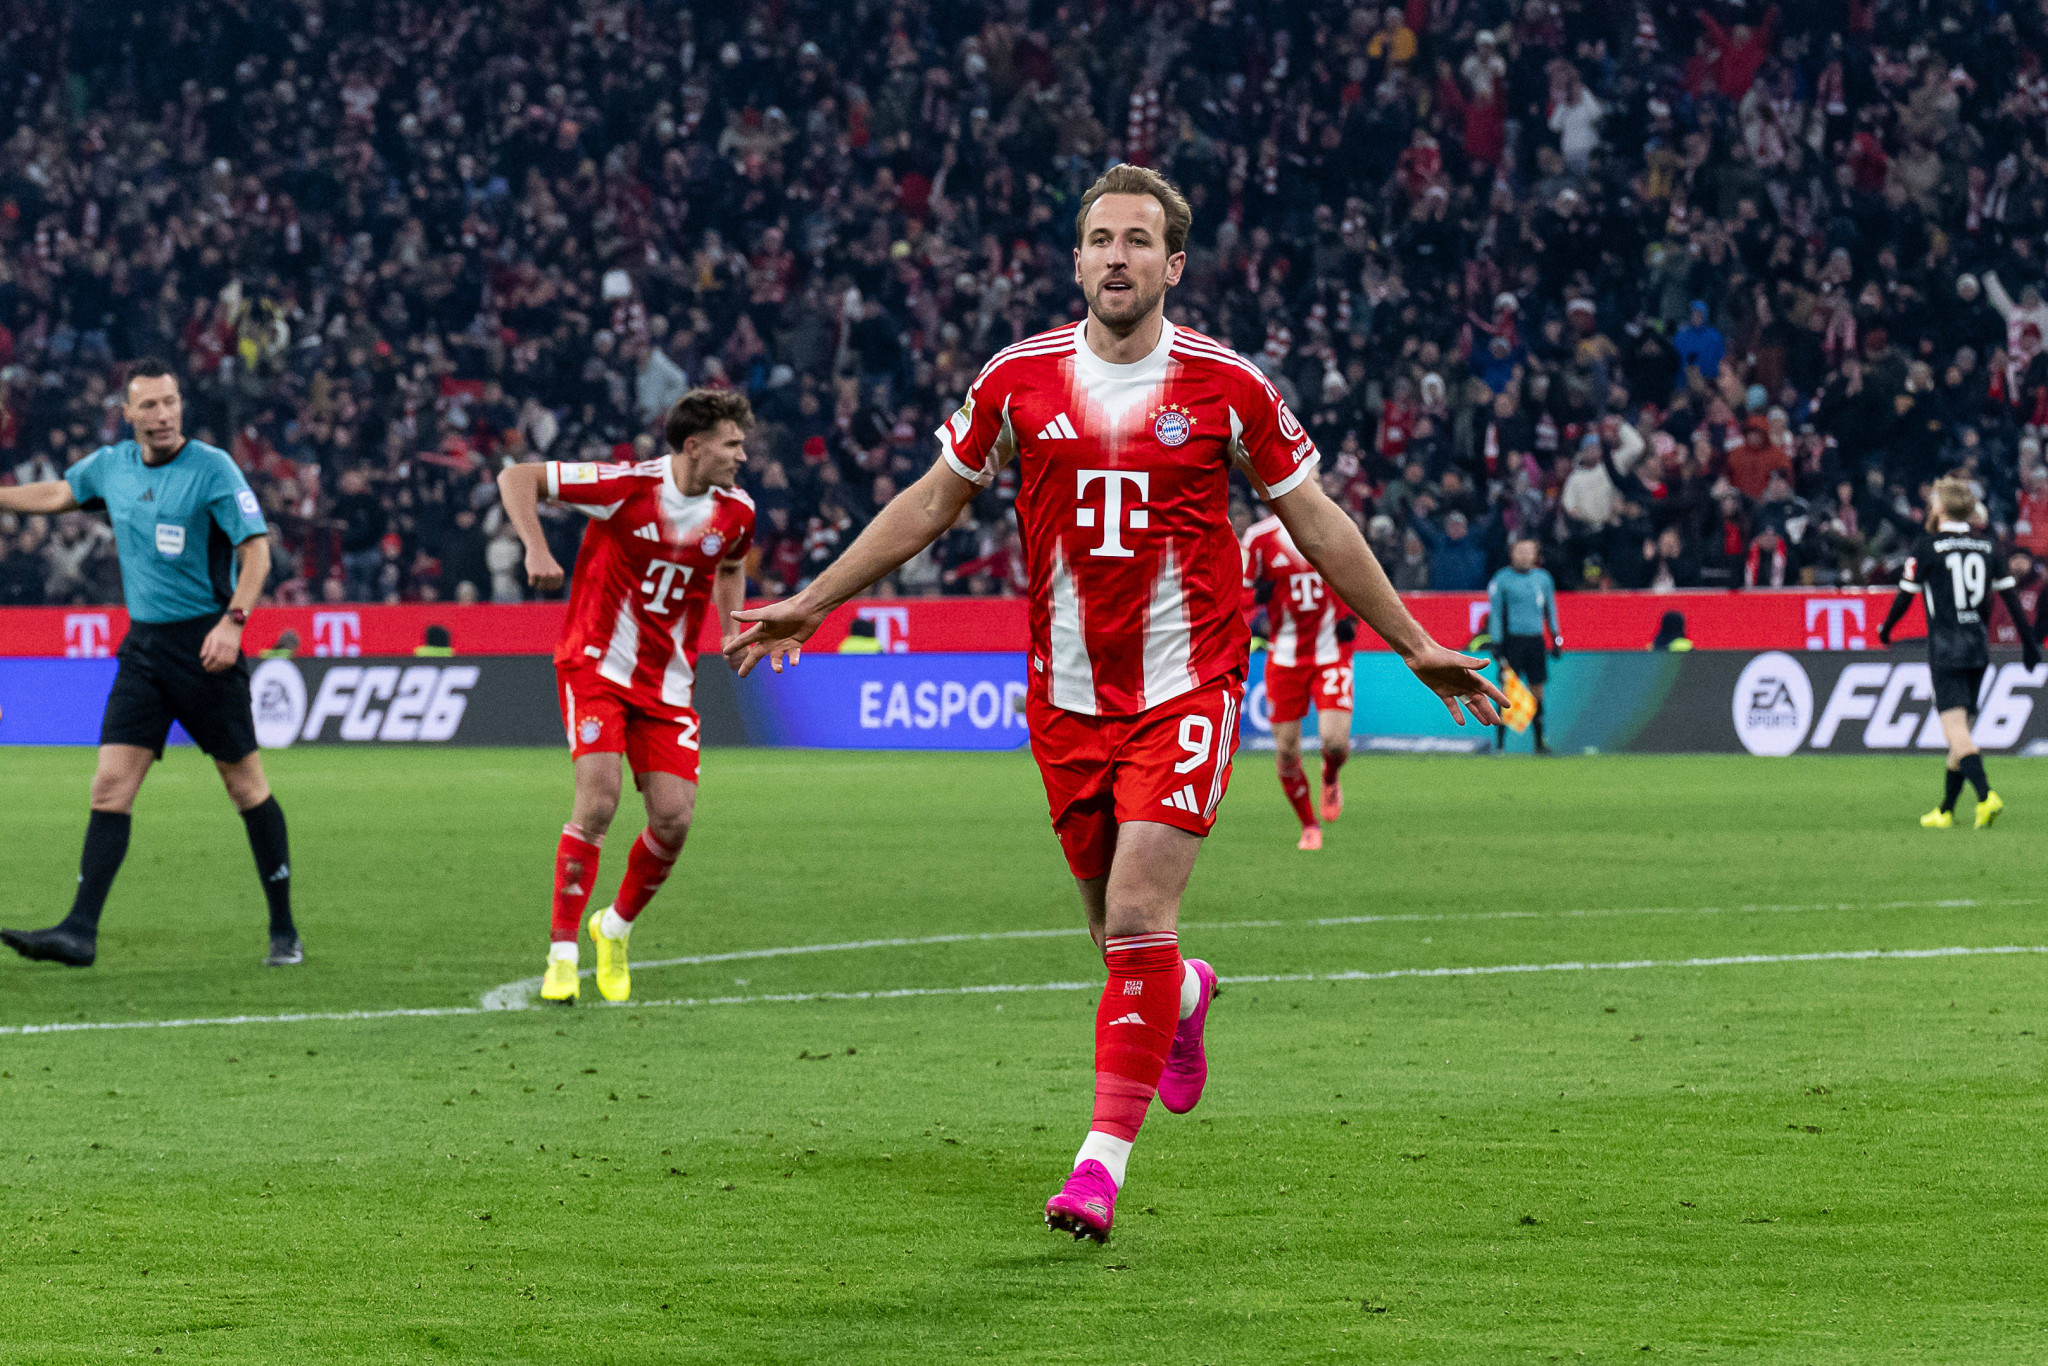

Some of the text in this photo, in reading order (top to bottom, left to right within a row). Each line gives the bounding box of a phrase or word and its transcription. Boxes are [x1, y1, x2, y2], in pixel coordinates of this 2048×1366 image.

[1166, 415, 1187, 428] BAYERN
[1076, 469, 1149, 557] T
[641, 558, 694, 615] T
[1289, 572, 1324, 611] T
[1945, 552, 1986, 609] 19
[64, 613, 110, 658] T
[313, 611, 360, 658] T
[1805, 598, 1866, 651] T
[302, 665, 481, 741] FC26
[1322, 667, 1353, 695] 27
[1174, 714, 1213, 774] 9
